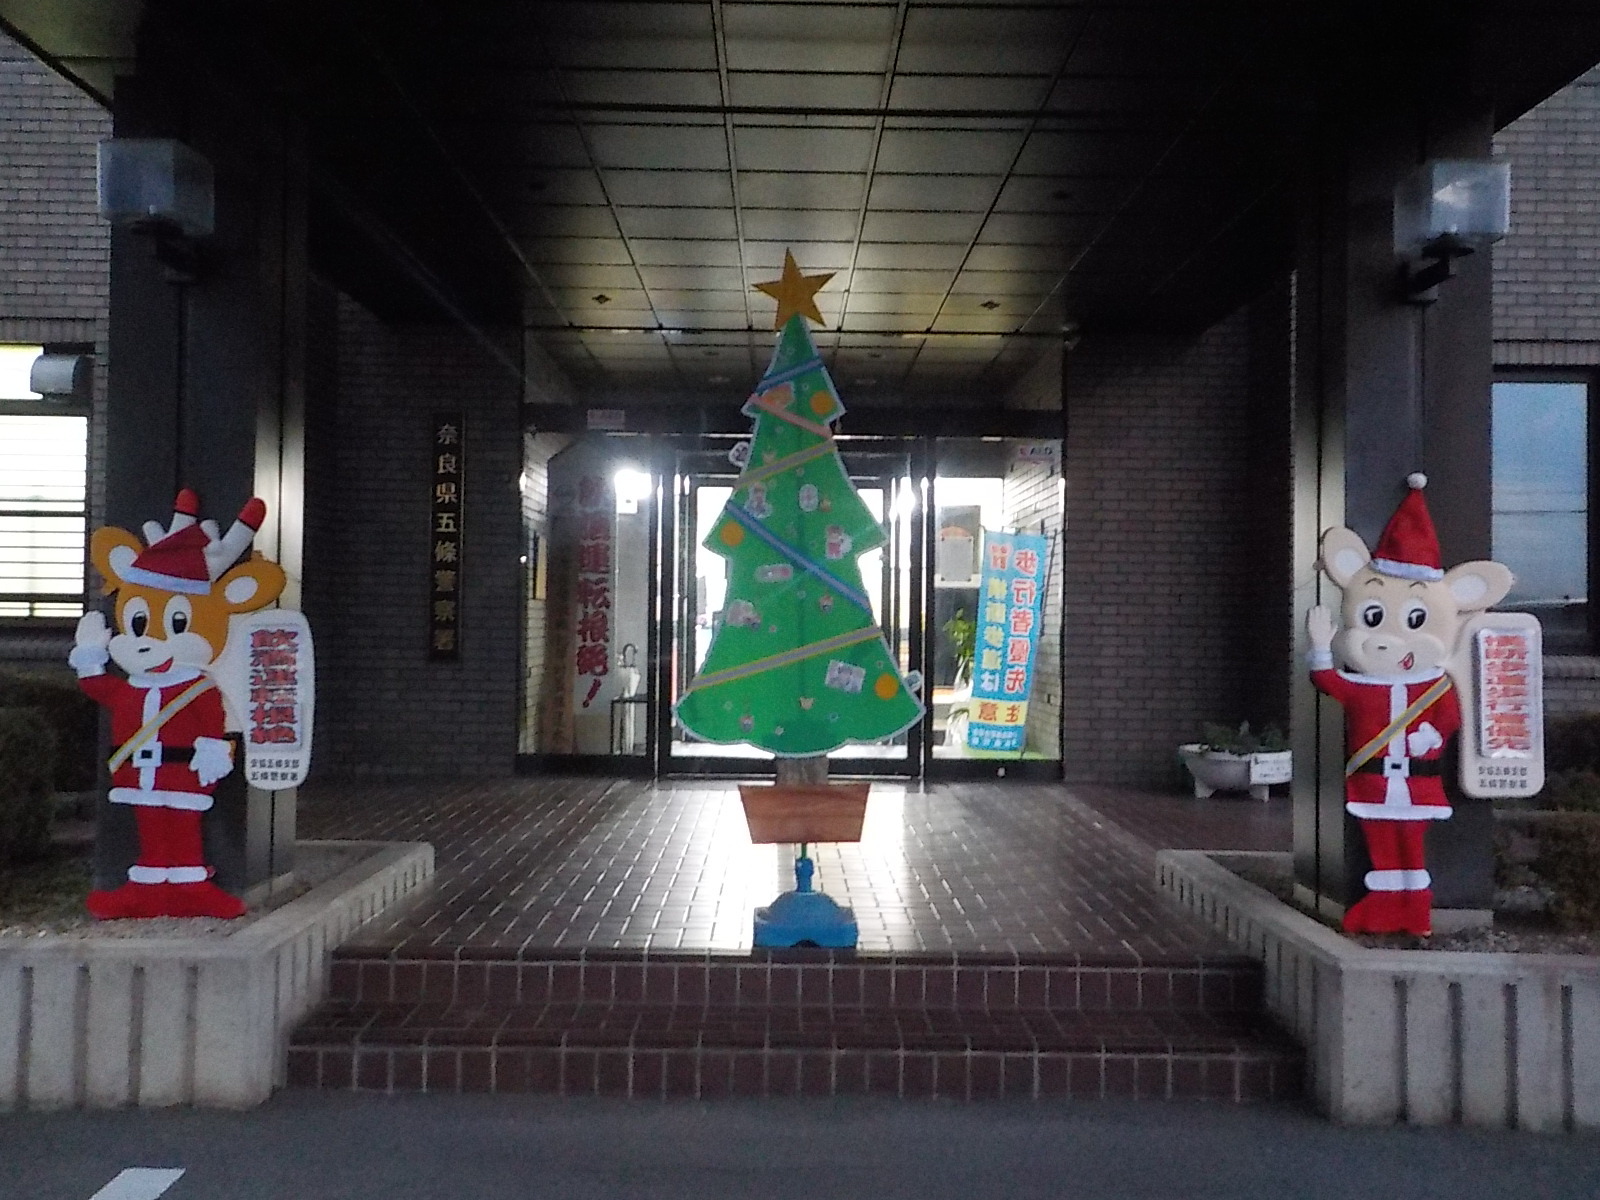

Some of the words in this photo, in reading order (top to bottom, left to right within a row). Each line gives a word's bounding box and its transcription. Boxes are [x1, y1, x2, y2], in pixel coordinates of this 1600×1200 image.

[434, 423, 459, 650] 奈良県五條警察署
